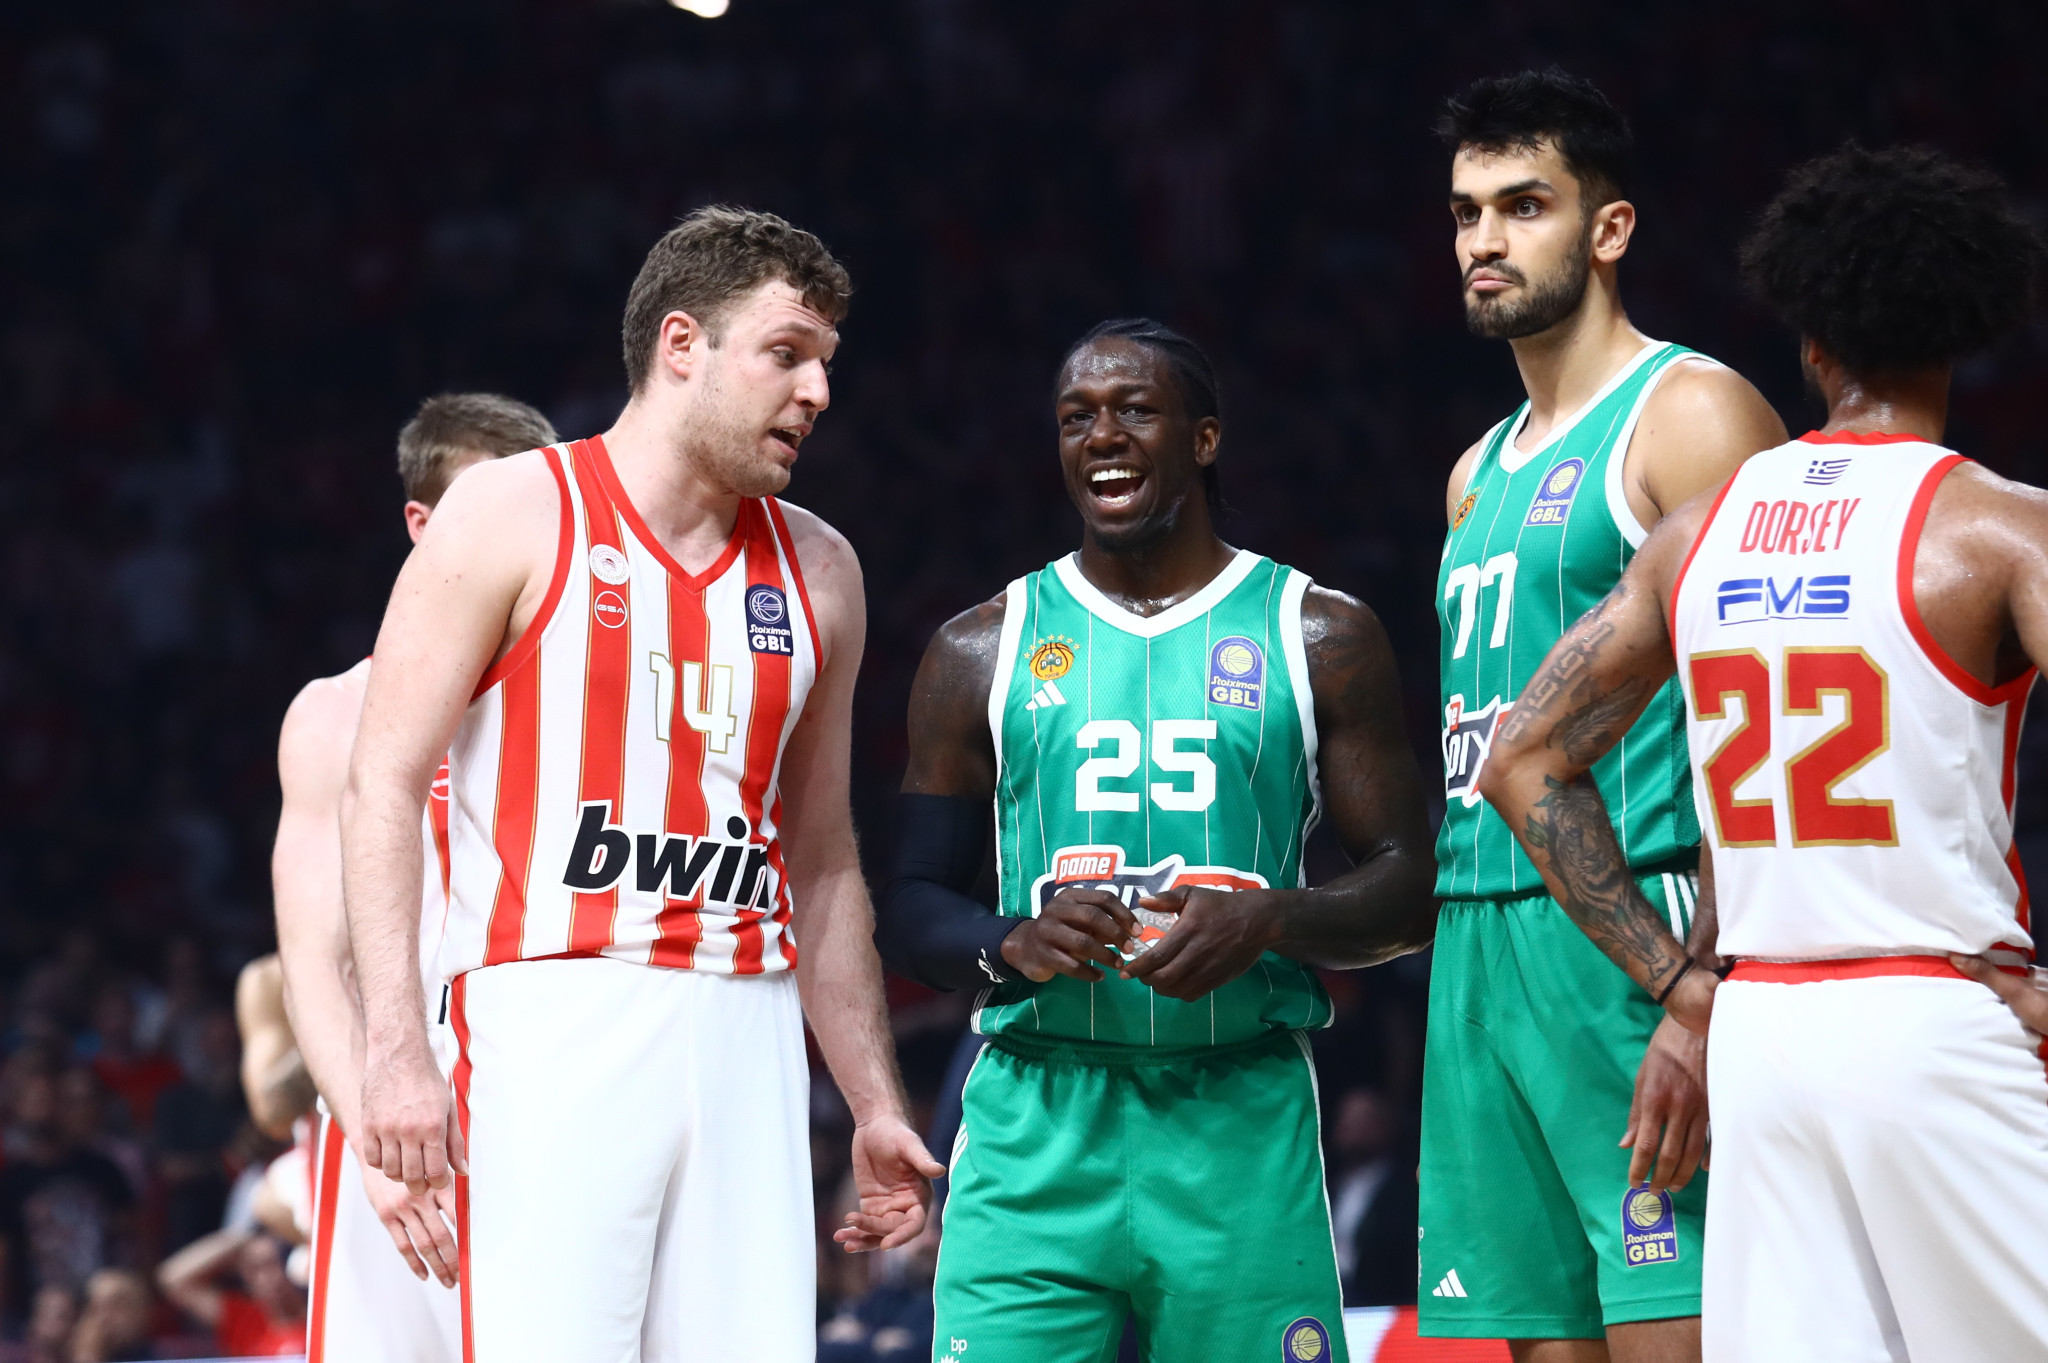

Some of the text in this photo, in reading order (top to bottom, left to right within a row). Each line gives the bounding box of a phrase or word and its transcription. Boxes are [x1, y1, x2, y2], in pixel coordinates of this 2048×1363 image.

[1530, 506, 1563, 523] GBL
[1739, 498, 1861, 555] DORSEY
[1444, 550, 1519, 660] 77
[1717, 574, 1851, 620] FMS
[749, 624, 791, 636] Stoiximan
[752, 634, 791, 653] GBL
[1211, 676, 1260, 691] Stoiximan
[649, 651, 738, 755] 14
[1212, 686, 1256, 707] GBL
[1689, 646, 1900, 849] 22
[1075, 719, 1217, 812] 25
[561, 801, 770, 911] bwin
[1058, 856, 1111, 880] pame
[1626, 1232, 1674, 1245] Stoiximan
[1629, 1241, 1673, 1262] GBL
[951, 1336, 968, 1355] bp
